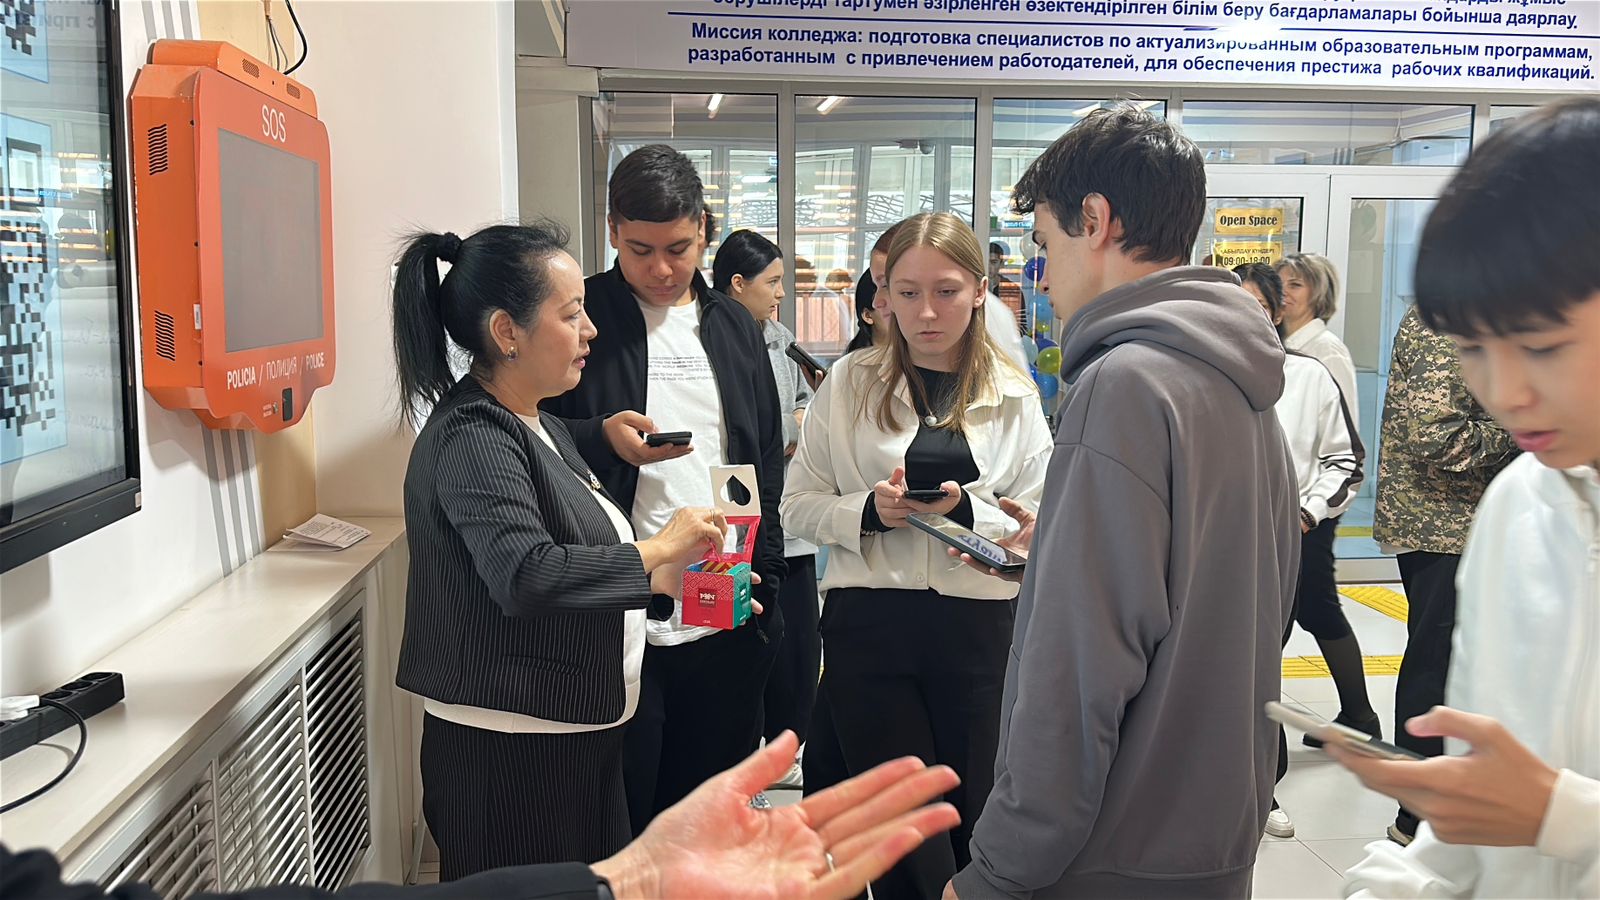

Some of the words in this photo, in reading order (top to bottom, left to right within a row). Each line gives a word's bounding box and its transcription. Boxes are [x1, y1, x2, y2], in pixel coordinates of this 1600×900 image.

[924, 0, 1020, 13] әзірленген
[1026, 0, 1167, 17] өзектендірілген
[1173, 0, 1217, 16] білім
[1223, 1, 1264, 20] беру
[1269, 2, 1416, 24] бағдарламалары
[1422, 7, 1502, 24] бойынша
[1506, 13, 1577, 29] даярлау.
[692, 23, 761, 40] Миссия
[769, 29, 863, 44] колледжа:
[869, 32, 970, 47] подготовка
[977, 34, 1104, 49] специалистов
[1110, 36, 1131, 48] по
[1136, 37, 1316, 53] актуализированным
[1323, 38, 1479, 57] образовательным
[1485, 45, 1593, 62] программам,
[689, 47, 835, 65] разработанным
[846, 53, 856, 64] с
[862, 54, 993, 68] привлечением
[999, 52, 1138, 73] работодателей,
[1144, 59, 1177, 73] для
[1183, 56, 1295, 72] обеспечения
[1302, 61, 1381, 77] престижа
[1392, 60, 1462, 78] рабочих
[1468, 64, 1594, 81] квалификаций.
[262, 104, 286, 143] SOS
[1220, 215, 1246, 226] Open
[1249, 215, 1278, 226] Space
[227, 366, 256, 390] POLICIA
[266, 357, 297, 380] ПОЛИЦИЯ
[306, 352, 324, 370] POLICE
